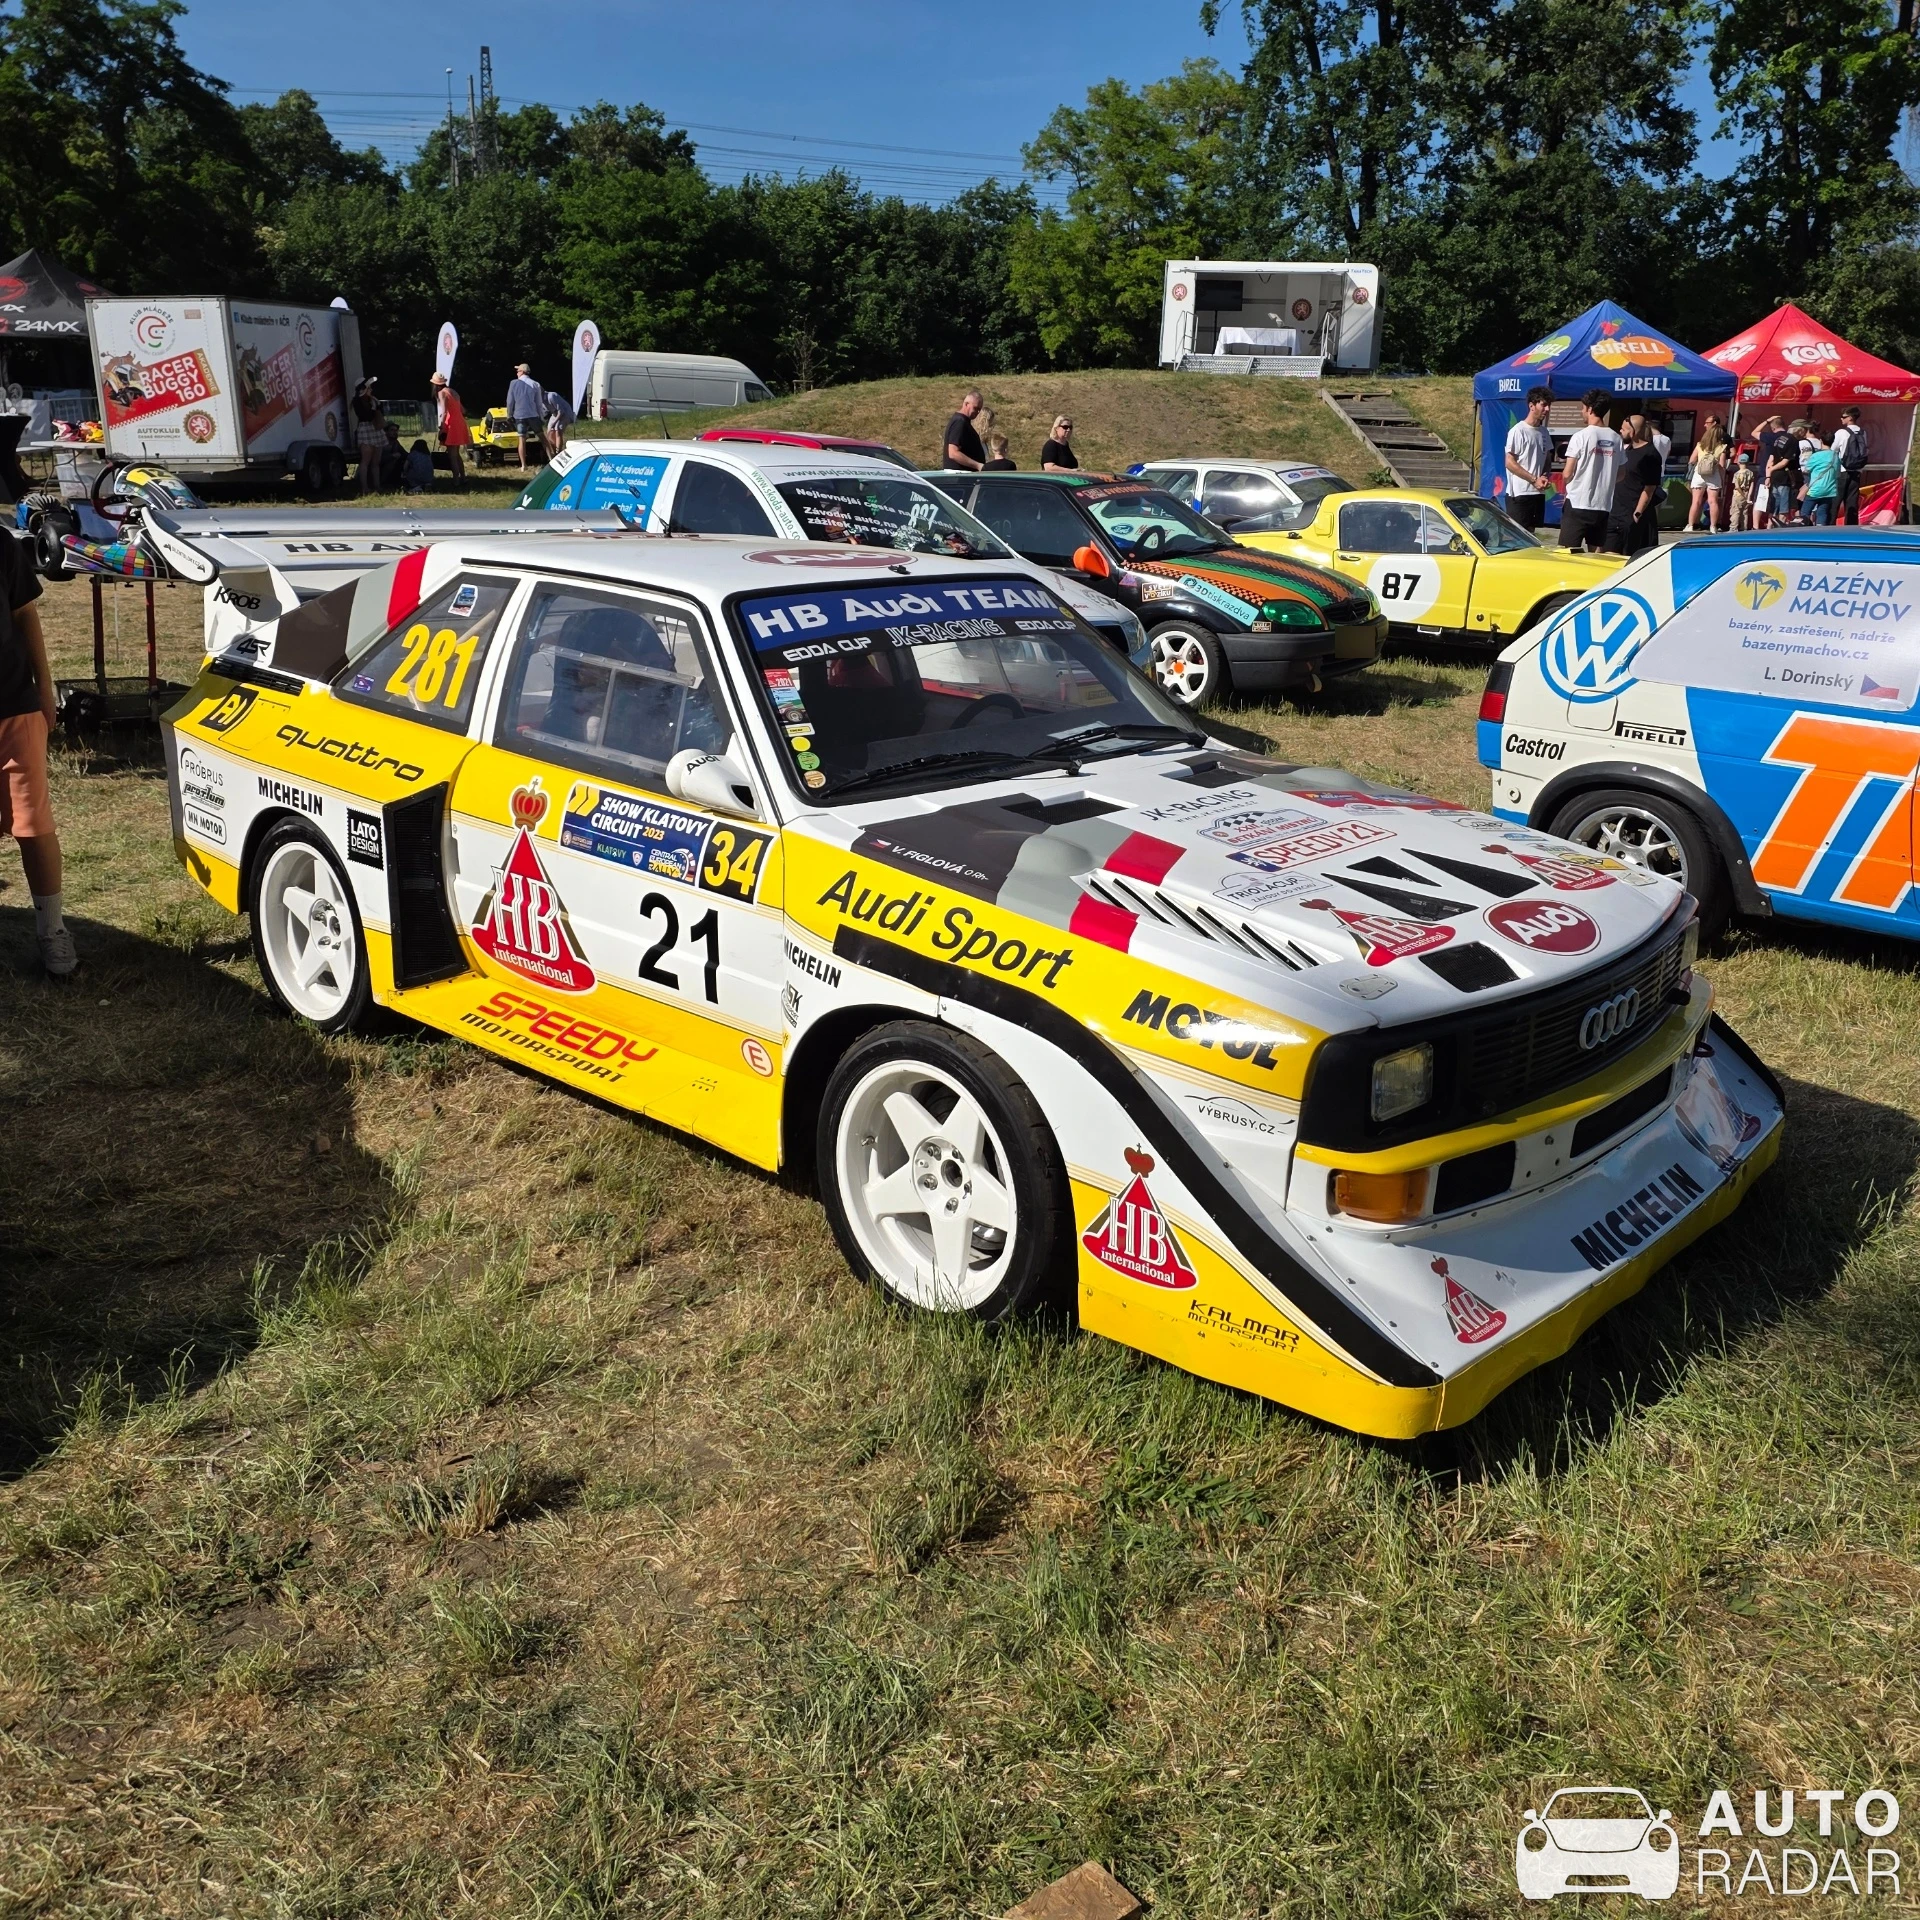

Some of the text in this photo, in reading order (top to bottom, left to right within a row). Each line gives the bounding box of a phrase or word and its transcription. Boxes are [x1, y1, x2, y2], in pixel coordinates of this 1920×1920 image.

[15, 320, 80, 333] 24MX
[129, 309, 143, 326] KLUB
[143, 305, 174, 324] MLÁDEŽE
[1590, 341, 1665, 355] BIRELL
[1781, 342, 1841, 365] Koli
[138, 356, 196, 386] RACER
[260, 351, 291, 385] RACER
[143, 369, 199, 400] BUGGY
[175, 383, 206, 402] 160
[281, 385, 298, 408] 160
[1498, 378, 1521, 392] BIRELL
[1614, 377, 1671, 391] BIRELL
[751, 470, 801, 541] www.skoda-auto.co
[796, 487, 861, 506] Nejlevnější
[803, 506, 852, 520] Závodní
[283, 543, 354, 553] HB
[212, 585, 261, 610] KROB
[1382, 573, 1422, 601] 87
[1797, 572, 1904, 598] BAZÉNY
[748, 602, 828, 639] HB
[946, 588, 1058, 612] TEAM
[1195, 583, 1250, 620] 3Dtiskrazdva
[1788, 595, 1912, 622] MACHOV
[885, 617, 1006, 647] JK-RACING
[1015, 620, 1077, 631] EDDA CUP
[1728, 617, 1896, 644] bazény, zastřešení, nádrže
[782, 636, 872, 662] EDDA CUP
[1741, 636, 1870, 660] bazenymachov.cz
[384, 623, 480, 709] 281
[1764, 667, 1854, 692] L. Dorinský
[1505, 733, 1567, 761] Castrol
[1614, 720, 1687, 746] PIRELLI
[276, 724, 425, 782] quattro
[184, 759, 224, 787] PROBRUS
[257, 776, 323, 816] MICHELIN
[1139, 789, 1257, 822] JK-RACING
[199, 816, 223, 837] MOTOR
[350, 818, 378, 841] LATO
[591, 812, 665, 841] CIRCUIT 2023
[600, 796, 710, 838] SHOW KLATOVY
[351, 835, 379, 854] DESIGN
[596, 842, 627, 859] KLATOVY
[650, 848, 677, 862] CENTRAL
[1253, 834, 1347, 865] SPEEDY
[1339, 823, 1385, 842] 21
[648, 861, 679, 877] RALLY
[703, 830, 764, 895] 34
[892, 845, 902, 854] V.
[902, 849, 966, 874] FIGLOVÁ
[1227, 877, 1299, 900] TRIOLACUP
[491, 865, 562, 962] HB
[816, 869, 1075, 990] Audi Sport
[1337, 915, 1426, 948] HB
[1387, 931, 1450, 956] international
[638, 892, 720, 1005] 21
[784, 935, 842, 989] MICHELIN
[493, 943, 575, 987] international
[476, 990, 659, 1069] SPEEDY
[459, 1012, 627, 1083] MOTORSPORT
[1198, 1104, 1276, 1135] VÝBRUSY.CZ
[1107, 1194, 1168, 1267] HB
[1570, 1162, 1705, 1272] MICHELIN
[1101, 1246, 1176, 1286] international
[1190, 1299, 1301, 1346] KALMAR
[1441, 1290, 1490, 1334] HB
[1187, 1311, 1299, 1353] MOTORSPORT
[1467, 1318, 1503, 1342] international
